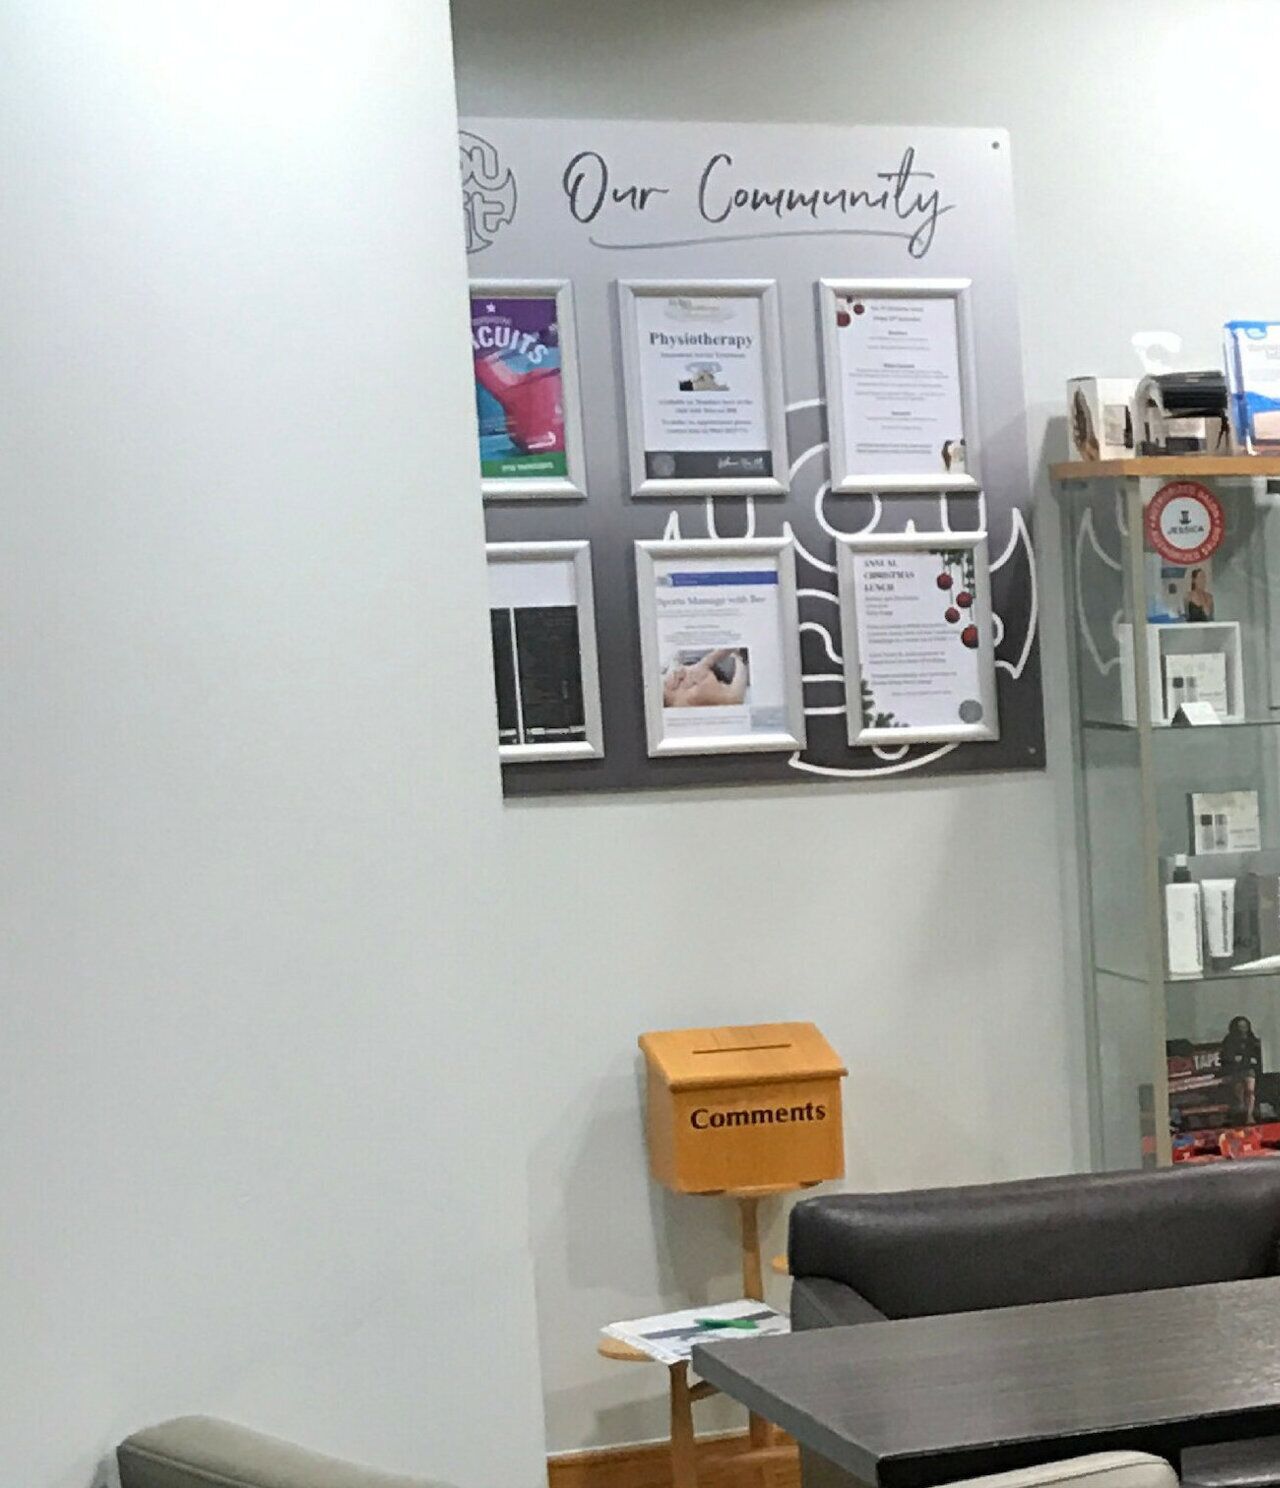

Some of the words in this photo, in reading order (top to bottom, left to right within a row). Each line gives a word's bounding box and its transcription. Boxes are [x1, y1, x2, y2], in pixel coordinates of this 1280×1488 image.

[562, 150, 670, 224] Our
[698, 146, 957, 259] Community
[472, 325, 549, 364] CUITS
[649, 332, 753, 348] Physiotherapy
[690, 1102, 827, 1130] Comments
